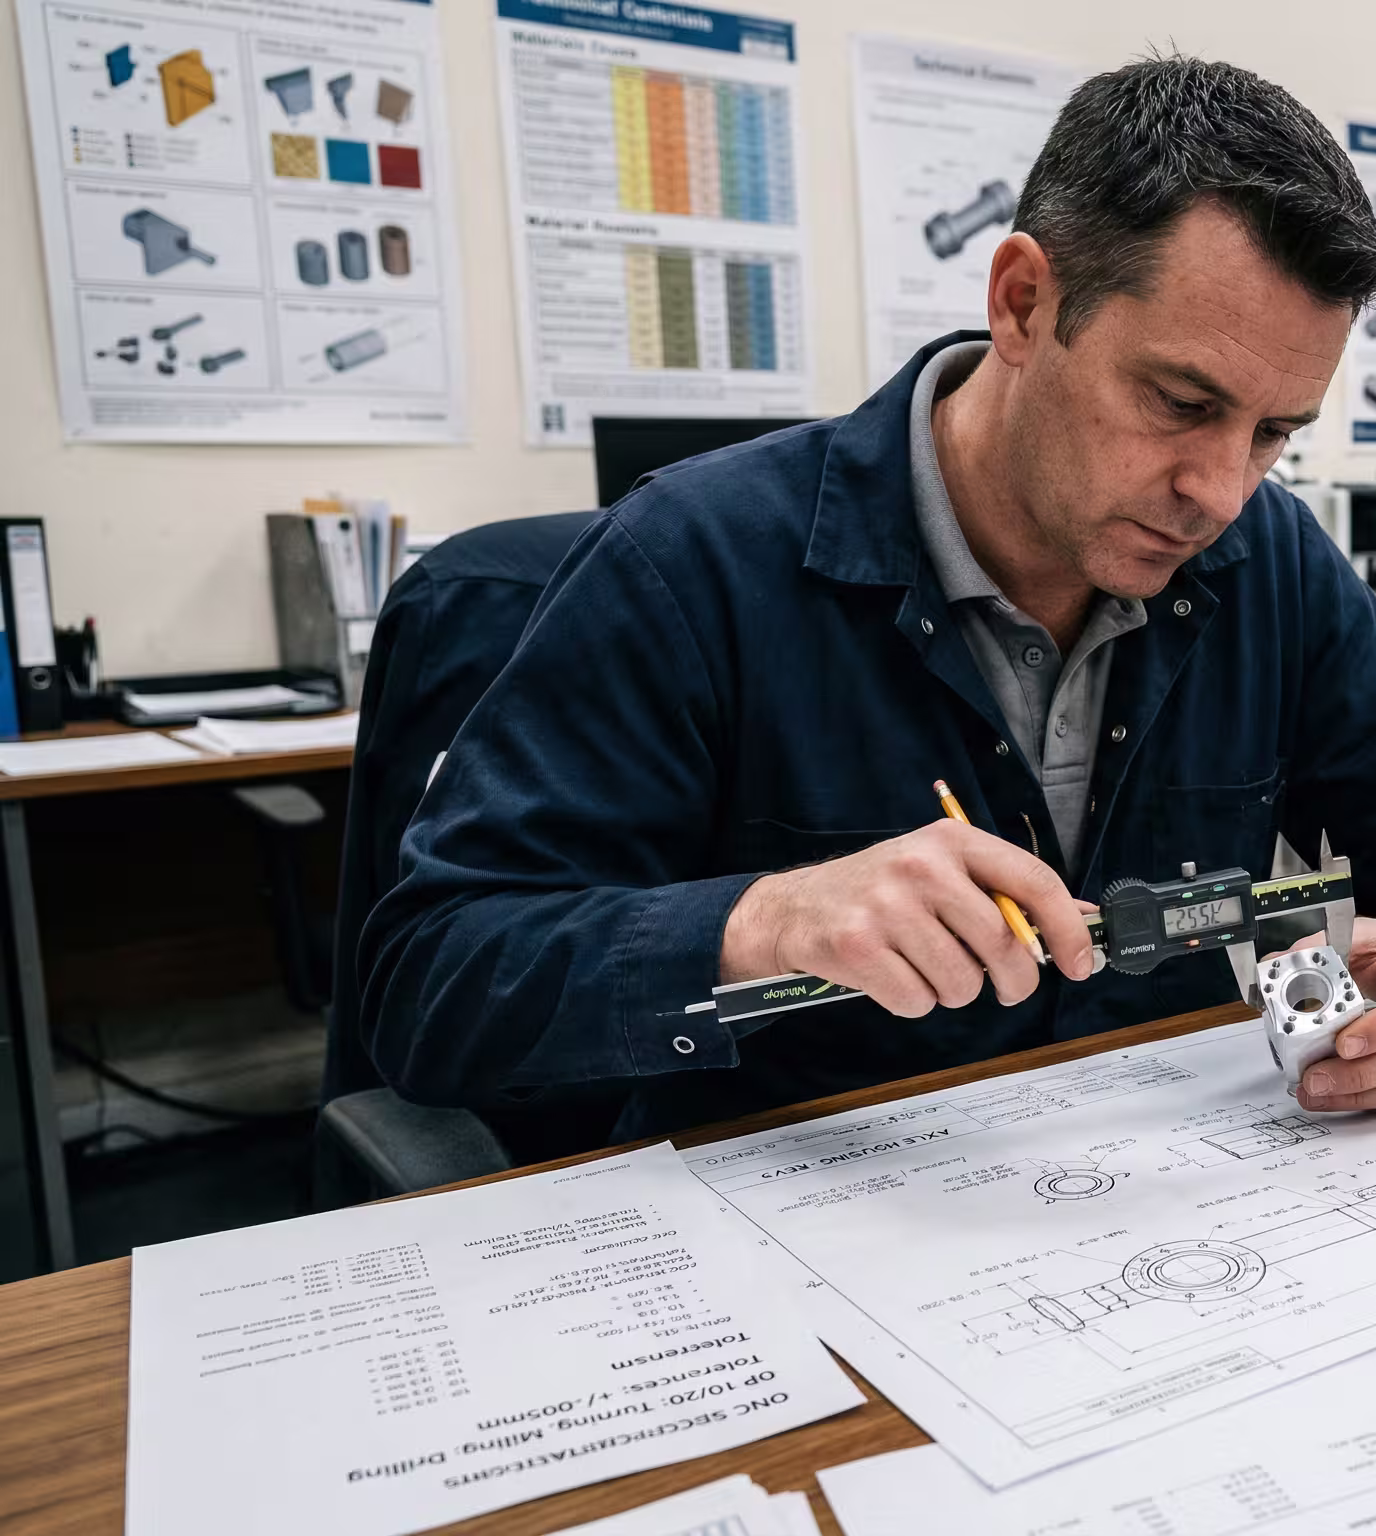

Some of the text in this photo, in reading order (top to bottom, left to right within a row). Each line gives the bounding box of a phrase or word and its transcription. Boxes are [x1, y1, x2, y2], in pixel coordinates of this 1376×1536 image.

[903, 1129, 950, 1146] AXLE
[820, 1141, 900, 1166] HOUSING
[743, 1370, 776, 1386] OP
[734, 1393, 789, 1416] ONC
